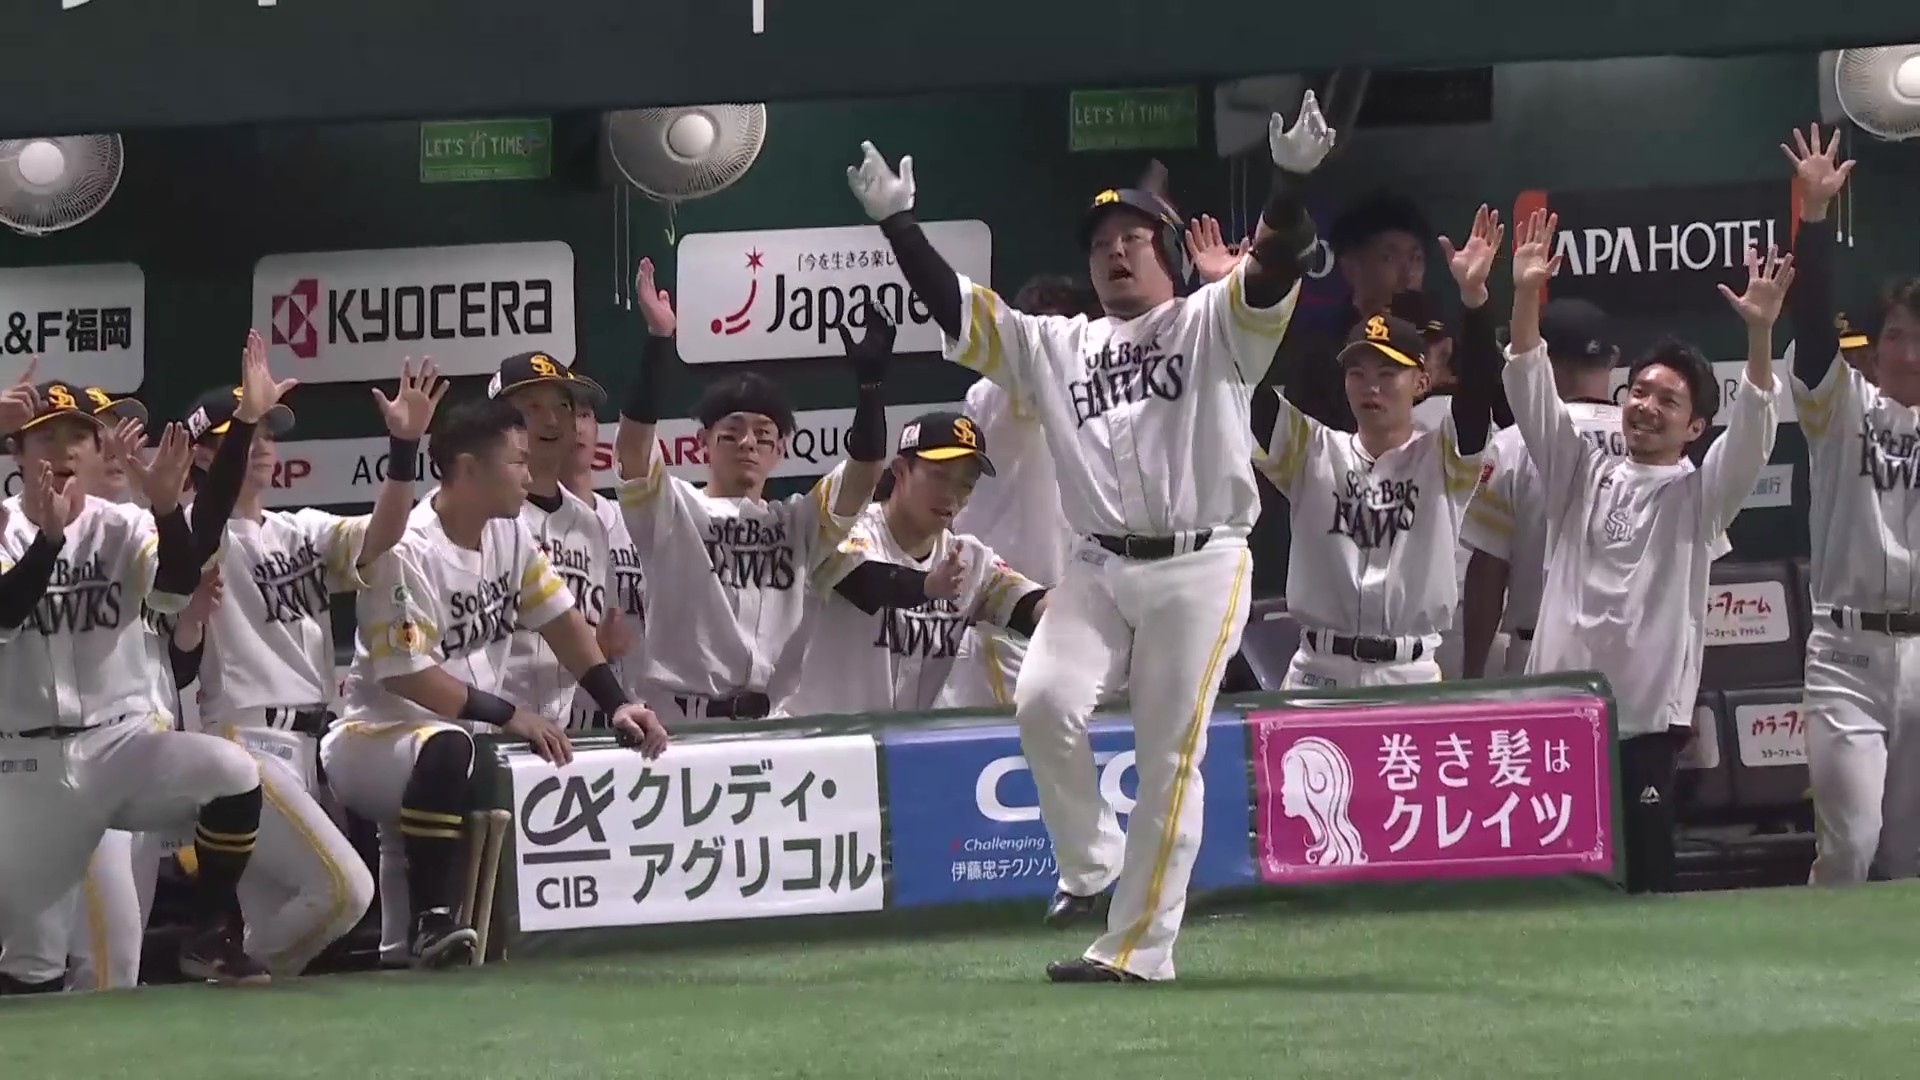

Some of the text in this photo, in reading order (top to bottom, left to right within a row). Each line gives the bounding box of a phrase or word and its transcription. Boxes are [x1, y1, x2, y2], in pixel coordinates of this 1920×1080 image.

[425, 138, 464, 157] LET'S
[797, 250, 896, 272] 「今を生きる楽し
[1551, 226, 1642, 277] APA
[0, 307, 131, 355] &F福岡
[328, 279, 552, 344] KYOCERA
[766, 274, 933, 344] Japane
[1377, 728, 1571, 791] 巻き髪は
[964, 836, 1045, 852] Challenging
[1383, 791, 1573, 853] クレイツ
[536, 875, 599, 909] CIB
[629, 832, 875, 905] アグリコル
[951, 857, 1059, 882] 伊藤忠テクノソリ
